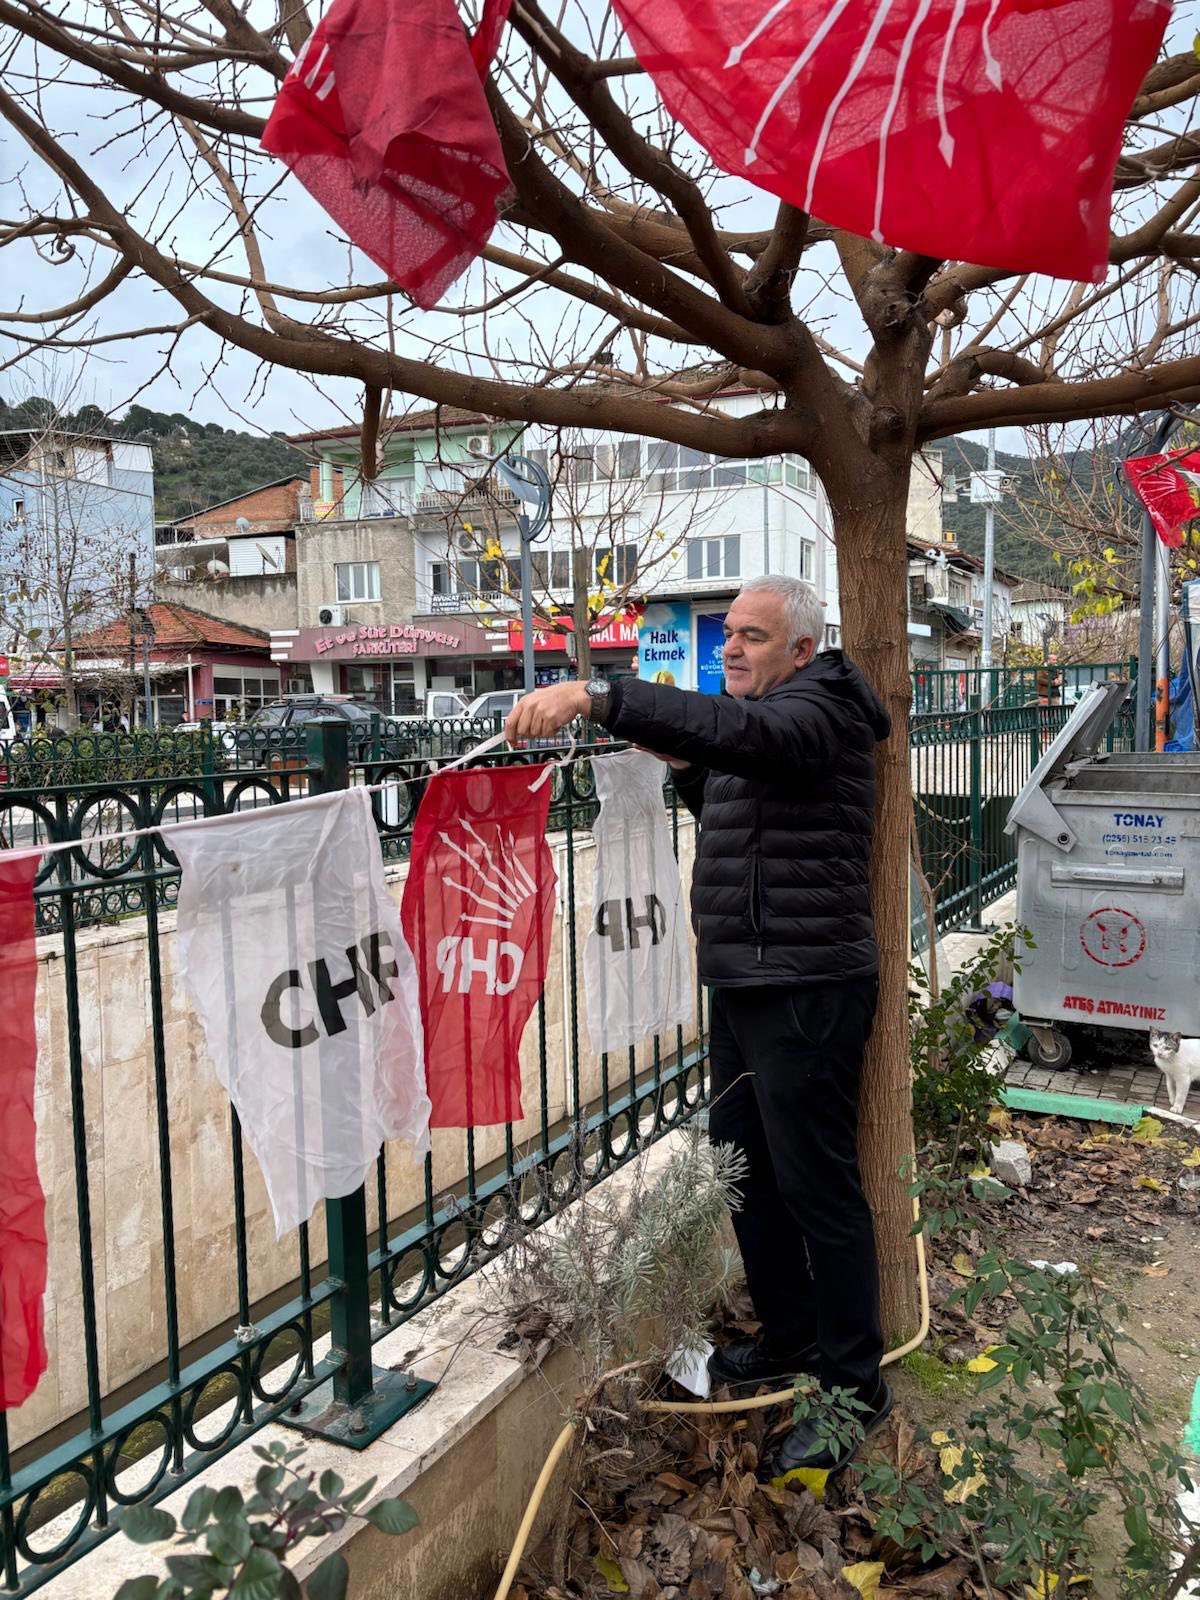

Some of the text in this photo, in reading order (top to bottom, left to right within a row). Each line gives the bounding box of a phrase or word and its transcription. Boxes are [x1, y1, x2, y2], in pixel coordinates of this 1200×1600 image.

[314, 638, 334, 654] Et
[335, 630, 357, 645] ve
[389, 624, 460, 648] Dünyası
[588, 622, 639, 643] NAL MA
[650, 629, 679, 644] Halk
[352, 638, 418, 655] ŞARKÜTERİ
[644, 646, 686, 662] Ekmek
[1113, 813, 1165, 828] TONAY
[1151, 835, 1162, 844] 23
[260, 930, 399, 1049] CHP
[1063, 995, 1167, 1021] ATEŞ ATMAYINIZ
